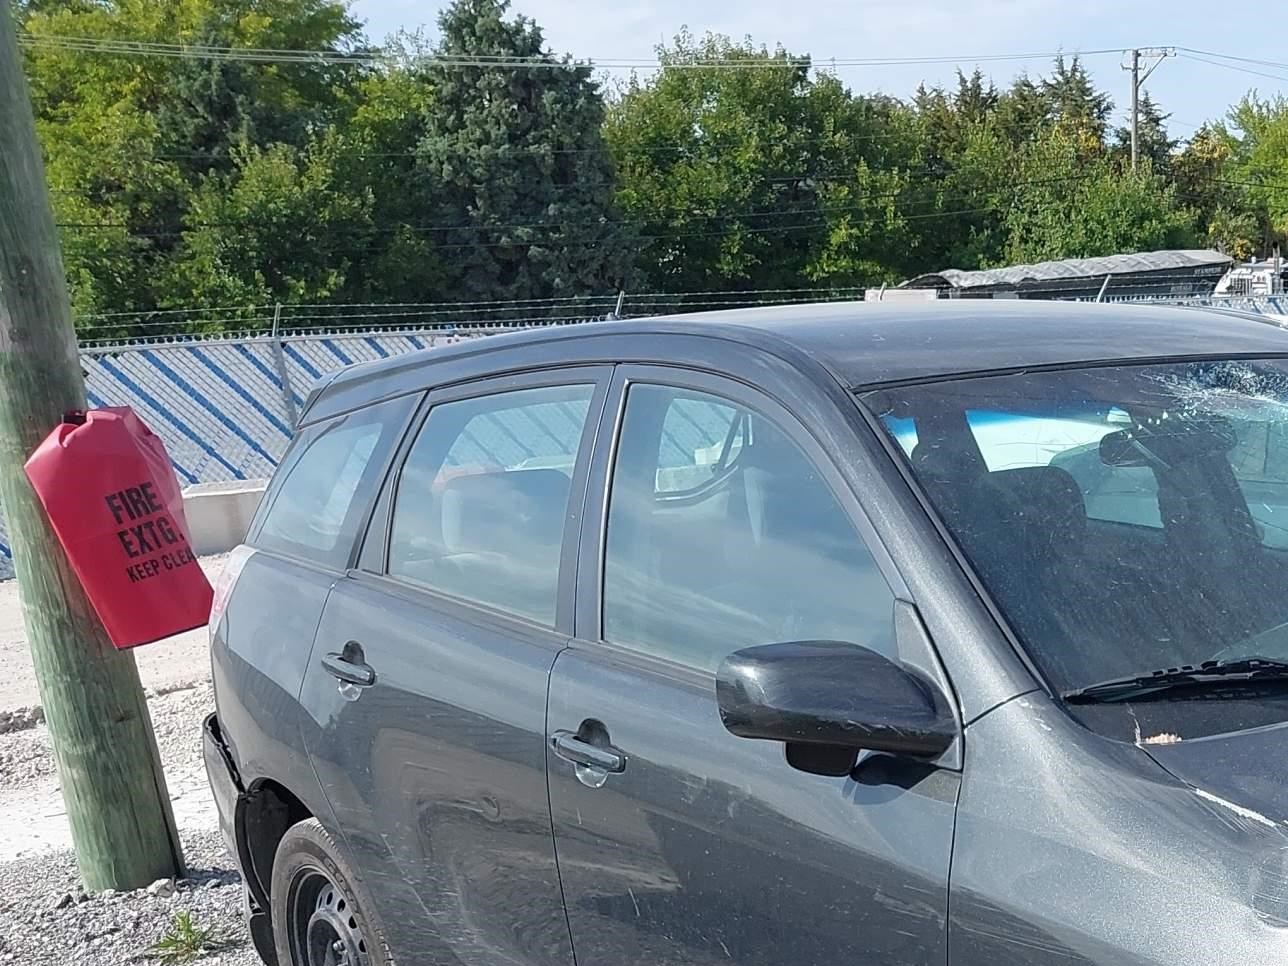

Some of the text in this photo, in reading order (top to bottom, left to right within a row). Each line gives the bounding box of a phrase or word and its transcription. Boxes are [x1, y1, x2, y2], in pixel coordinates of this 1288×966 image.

[104, 481, 163, 525] FIRE
[117, 516, 185, 559] EXTG.
[126, 559, 160, 584] KEEP
